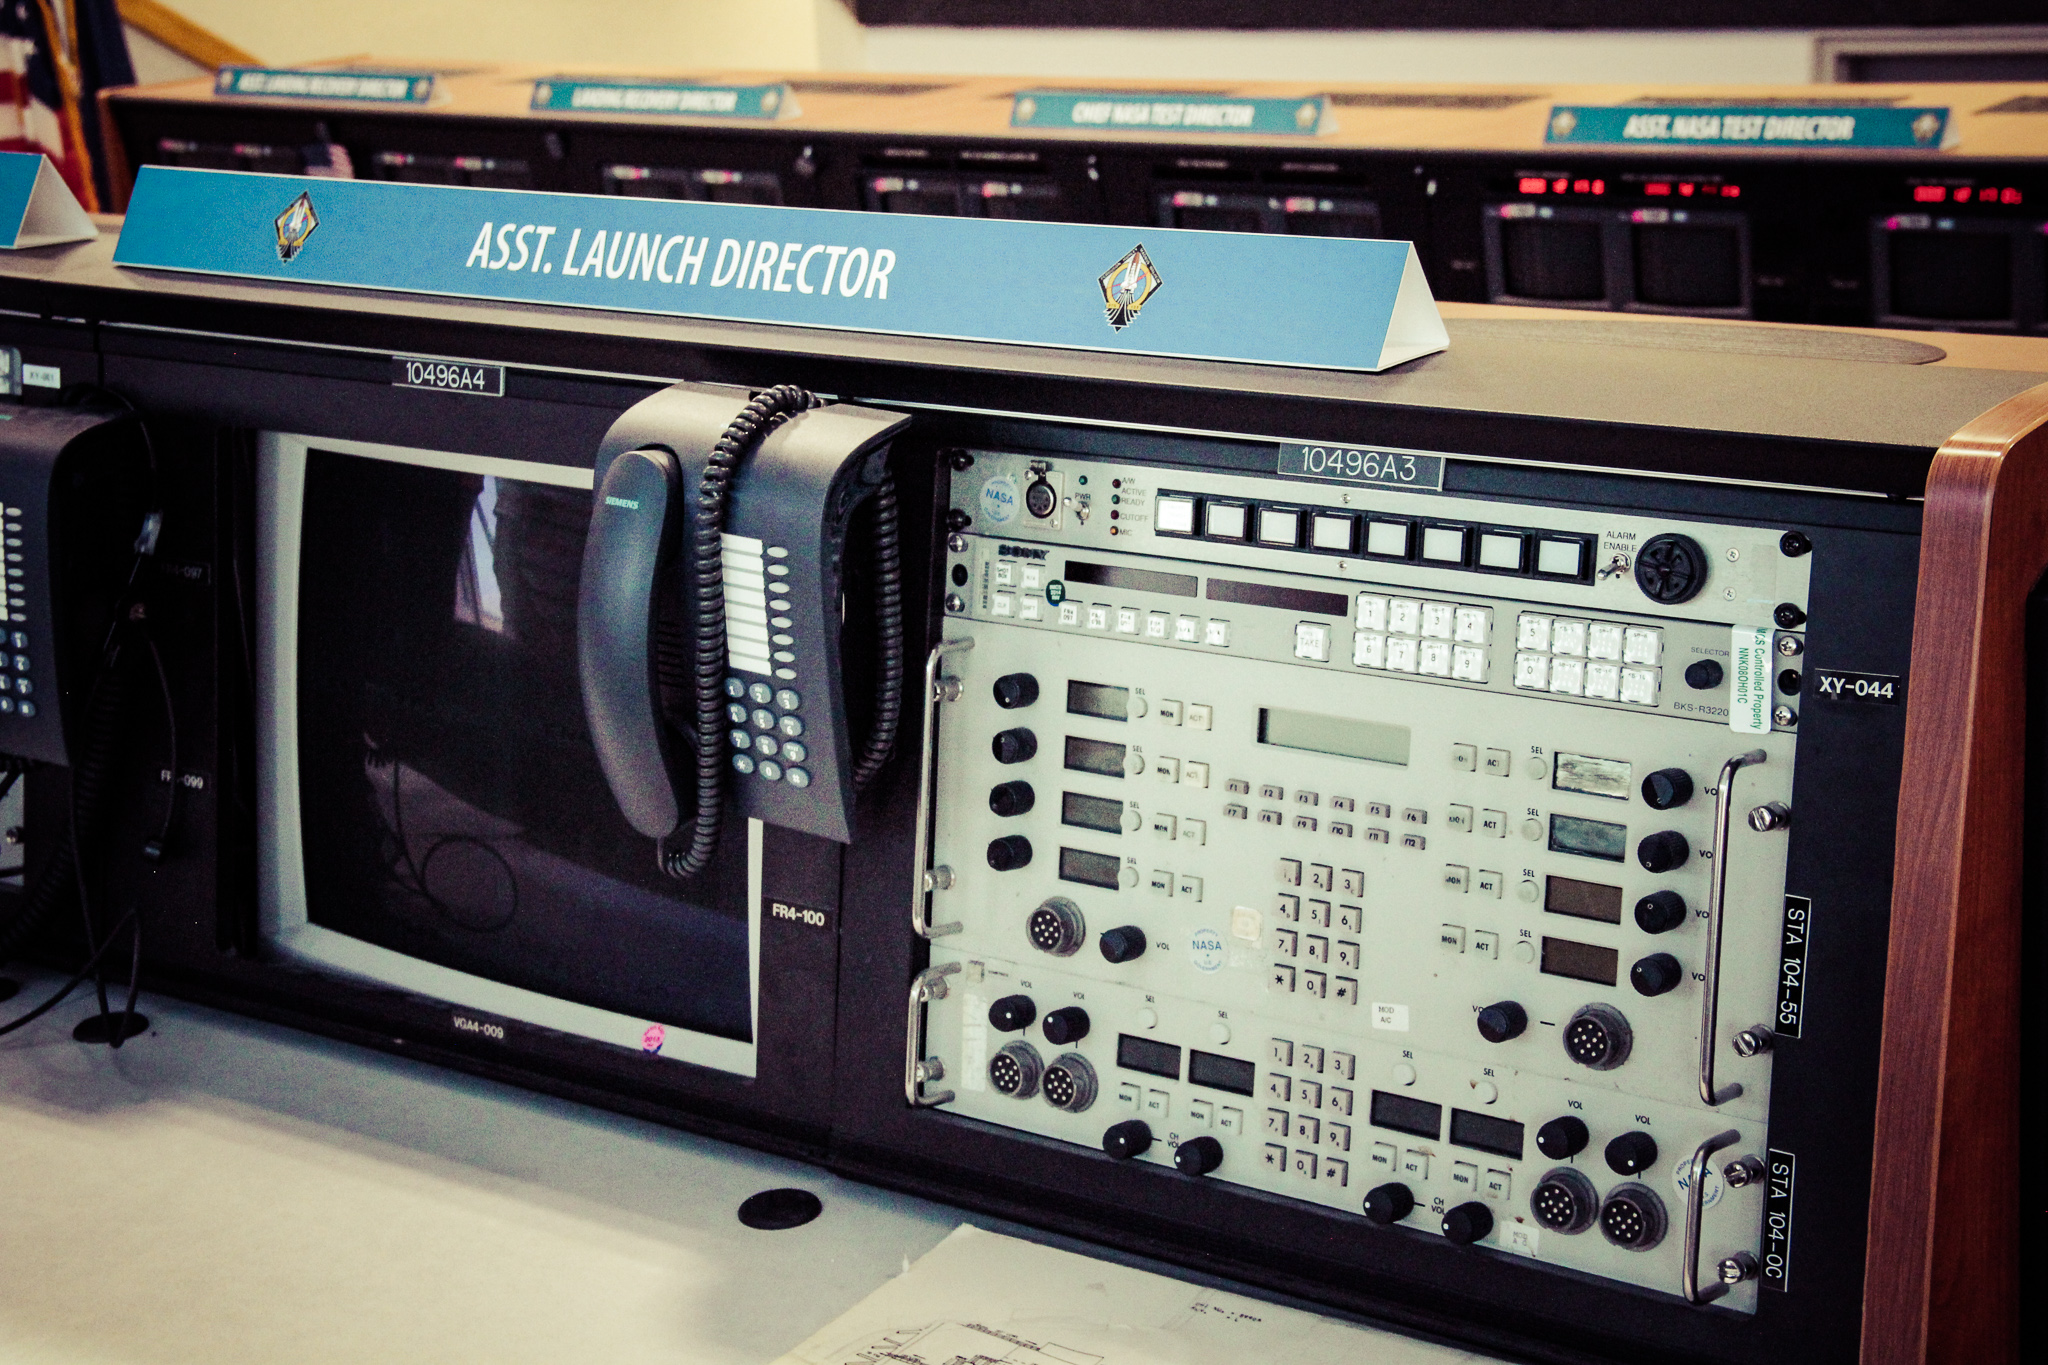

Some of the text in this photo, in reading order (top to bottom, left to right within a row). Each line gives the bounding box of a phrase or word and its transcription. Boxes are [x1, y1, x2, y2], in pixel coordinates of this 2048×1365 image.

[1182, 104, 1255, 127] DIRECTOR
[1721, 115, 1766, 140] TEST
[1763, 115, 1856, 141] DIRECTOR
[466, 222, 897, 300] ASST. LAUNCH DIRECTOR
[406, 362, 485, 390] 10496A4
[1302, 446, 1417, 481] 10496A3
[1122, 477, 1135, 485] A/W
[1075, 492, 1091, 500] PWR
[1121, 487, 1147, 496] ACTIVE
[985, 488, 1014, 505] NASA
[605, 496, 639, 510] SIEMENS
[1121, 498, 1145, 507] READY
[1120, 512, 1149, 522] CUTOFF
[1119, 529, 1133, 537] MIC
[1606, 530, 1637, 541] ALARM
[1603, 541, 1637, 552] ENABLE
[1400, 613, 1405, 621] 2
[1435, 616, 1440, 625] 3
[1467, 622, 1473, 630] 4
[1530, 628, 1536, 637] 5
[1300, 637, 1319, 648] TAKE
[1366, 645, 1372, 654] 6
[1691, 646, 1730, 657] SELECTOR
[1400, 651, 1404, 659] 7
[1431, 654, 1436, 662] 8
[1465, 660, 1470, 668] 9
[1527, 666, 1533, 674] 0
[1754, 647, 1766, 695] Controlled
[1135, 687, 1145, 695] SEL
[1819, 675, 1894, 699] XY-044
[1673, 701, 1729, 717] BKS-R3220
[1750, 694, 1764, 730] Property
[1160, 710, 1174, 718] MON
[1132, 745, 1143, 753] SEL
[1531, 746, 1543, 755] SEL
[161, 769, 204, 789] FR-099
[1704, 786, 1718, 796] VO
[1130, 801, 1139, 809] SEL
[1527, 808, 1539, 817] SEL
[1154, 824, 1168, 832] MON
[1483, 821, 1497, 829] ACT
[1699, 850, 1713, 859] VO
[1127, 857, 1137, 865] SEL
[1523, 869, 1535, 878] SEL
[1313, 873, 1319, 884] 2
[1151, 881, 1165, 889] MON
[1344, 879, 1351, 889] 3
[1480, 882, 1493, 890] ACT
[1181, 885, 1193, 893] ACT
[1280, 904, 1286, 913] 4
[773, 903, 825, 926] FR4-100
[1311, 910, 1317, 919] 5
[1695, 910, 1709, 919] VO
[1341, 915, 1348, 925] 6
[1520, 929, 1532, 938] SEL
[1278, 939, 1284, 949] 7
[1442, 936, 1457, 945] MON
[1156, 942, 1170, 951] VOL
[1192, 940, 1222, 951] NASA
[1309, 945, 1315, 955] 8
[1476, 942, 1489, 951] ACT
[1340, 952, 1347, 962] 9
[1780, 909, 1804, 1024] STA 104-55
[1692, 972, 1705, 981] VO
[1020, 979, 1032, 989] VOL
[1307, 981, 1314, 990] 0
[1073, 991, 1085, 1000] VOL
[1145, 995, 1155, 1003] SEL
[1218, 1010, 1229, 1019] SEL
[1378, 1006, 1394, 1014] MOD
[1380, 1016, 1392, 1024] A/C
[1274, 1047, 1278, 1057] 1
[1402, 1050, 1414, 1059] SEL
[1304, 1053, 1310, 1063] 2
[1335, 1060, 1341, 1070] 3
[1483, 1067, 1495, 1077] SEL
[1270, 1084, 1277, 1093] 4
[1119, 1094, 1132, 1102] MON
[1302, 1090, 1307, 1099] 5
[1148, 1101, 1159, 1109] ACT
[1332, 1097, 1338, 1106] 6
[1568, 1100, 1583, 1110] VOL
[1191, 1111, 1204, 1119] MON
[1635, 1114, 1651, 1125] VOL
[1220, 1119, 1232, 1127] ACT
[1268, 1118, 1274, 1128] 7
[1300, 1125, 1305, 1135] 8
[1170, 1132, 1179, 1140] CH
[1330, 1132, 1336, 1142] 9
[1372, 1154, 1387, 1164] MON
[1297, 1160, 1304, 1170] 0
[1405, 1163, 1418, 1172] ACT
[1453, 1174, 1469, 1183] MON
[1770, 1163, 1789, 1199] STA
[1489, 1182, 1502, 1190] ACT
[1433, 1197, 1444, 1206] CH
